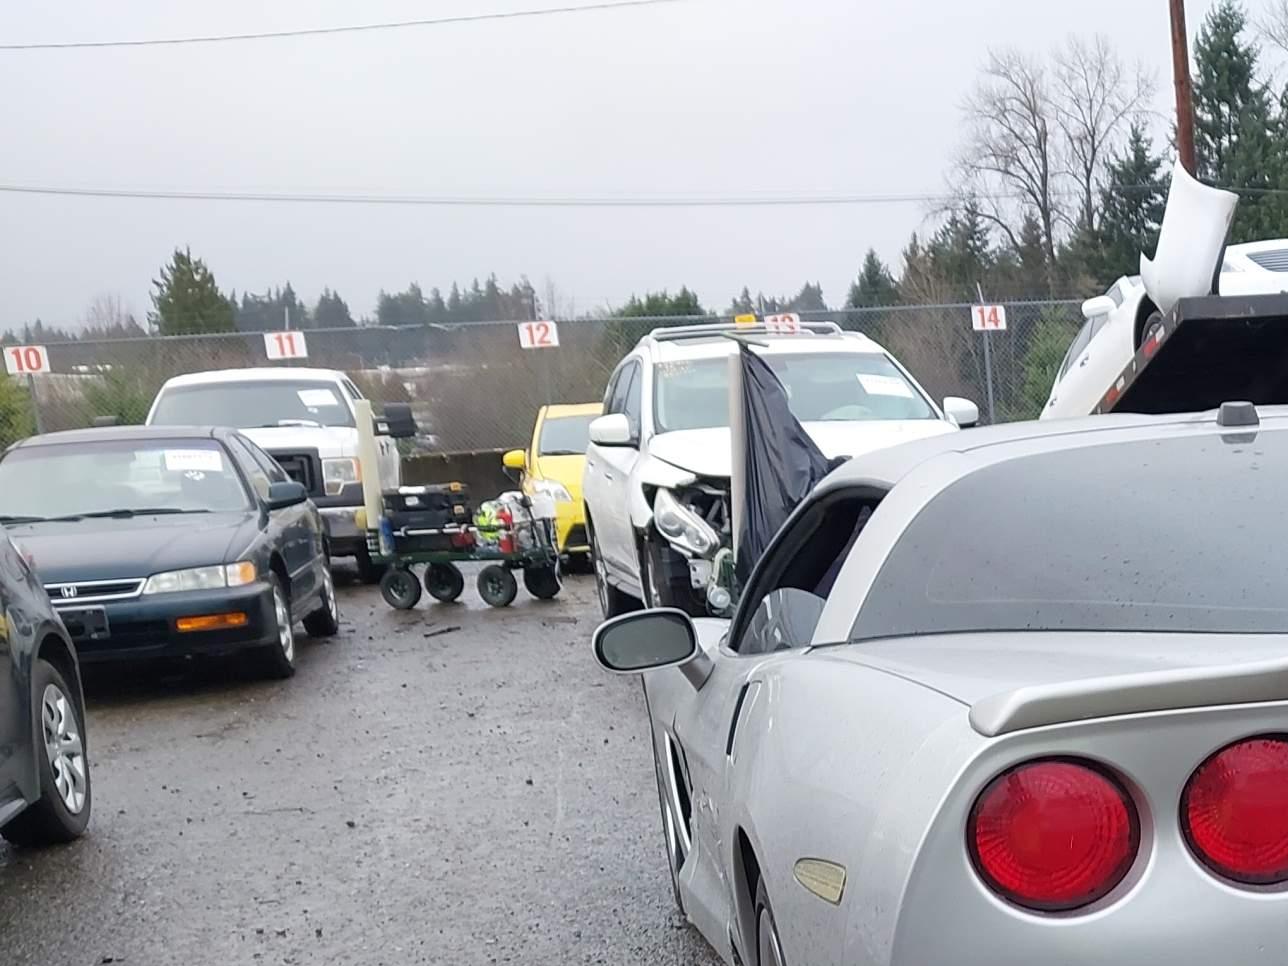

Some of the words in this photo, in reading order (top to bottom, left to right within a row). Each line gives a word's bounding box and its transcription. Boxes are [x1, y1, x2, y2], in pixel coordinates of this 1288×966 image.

[977, 305, 1001, 328] 14
[274, 334, 297, 356] 11
[526, 323, 552, 345] 12
[11, 347, 42, 371] 10
